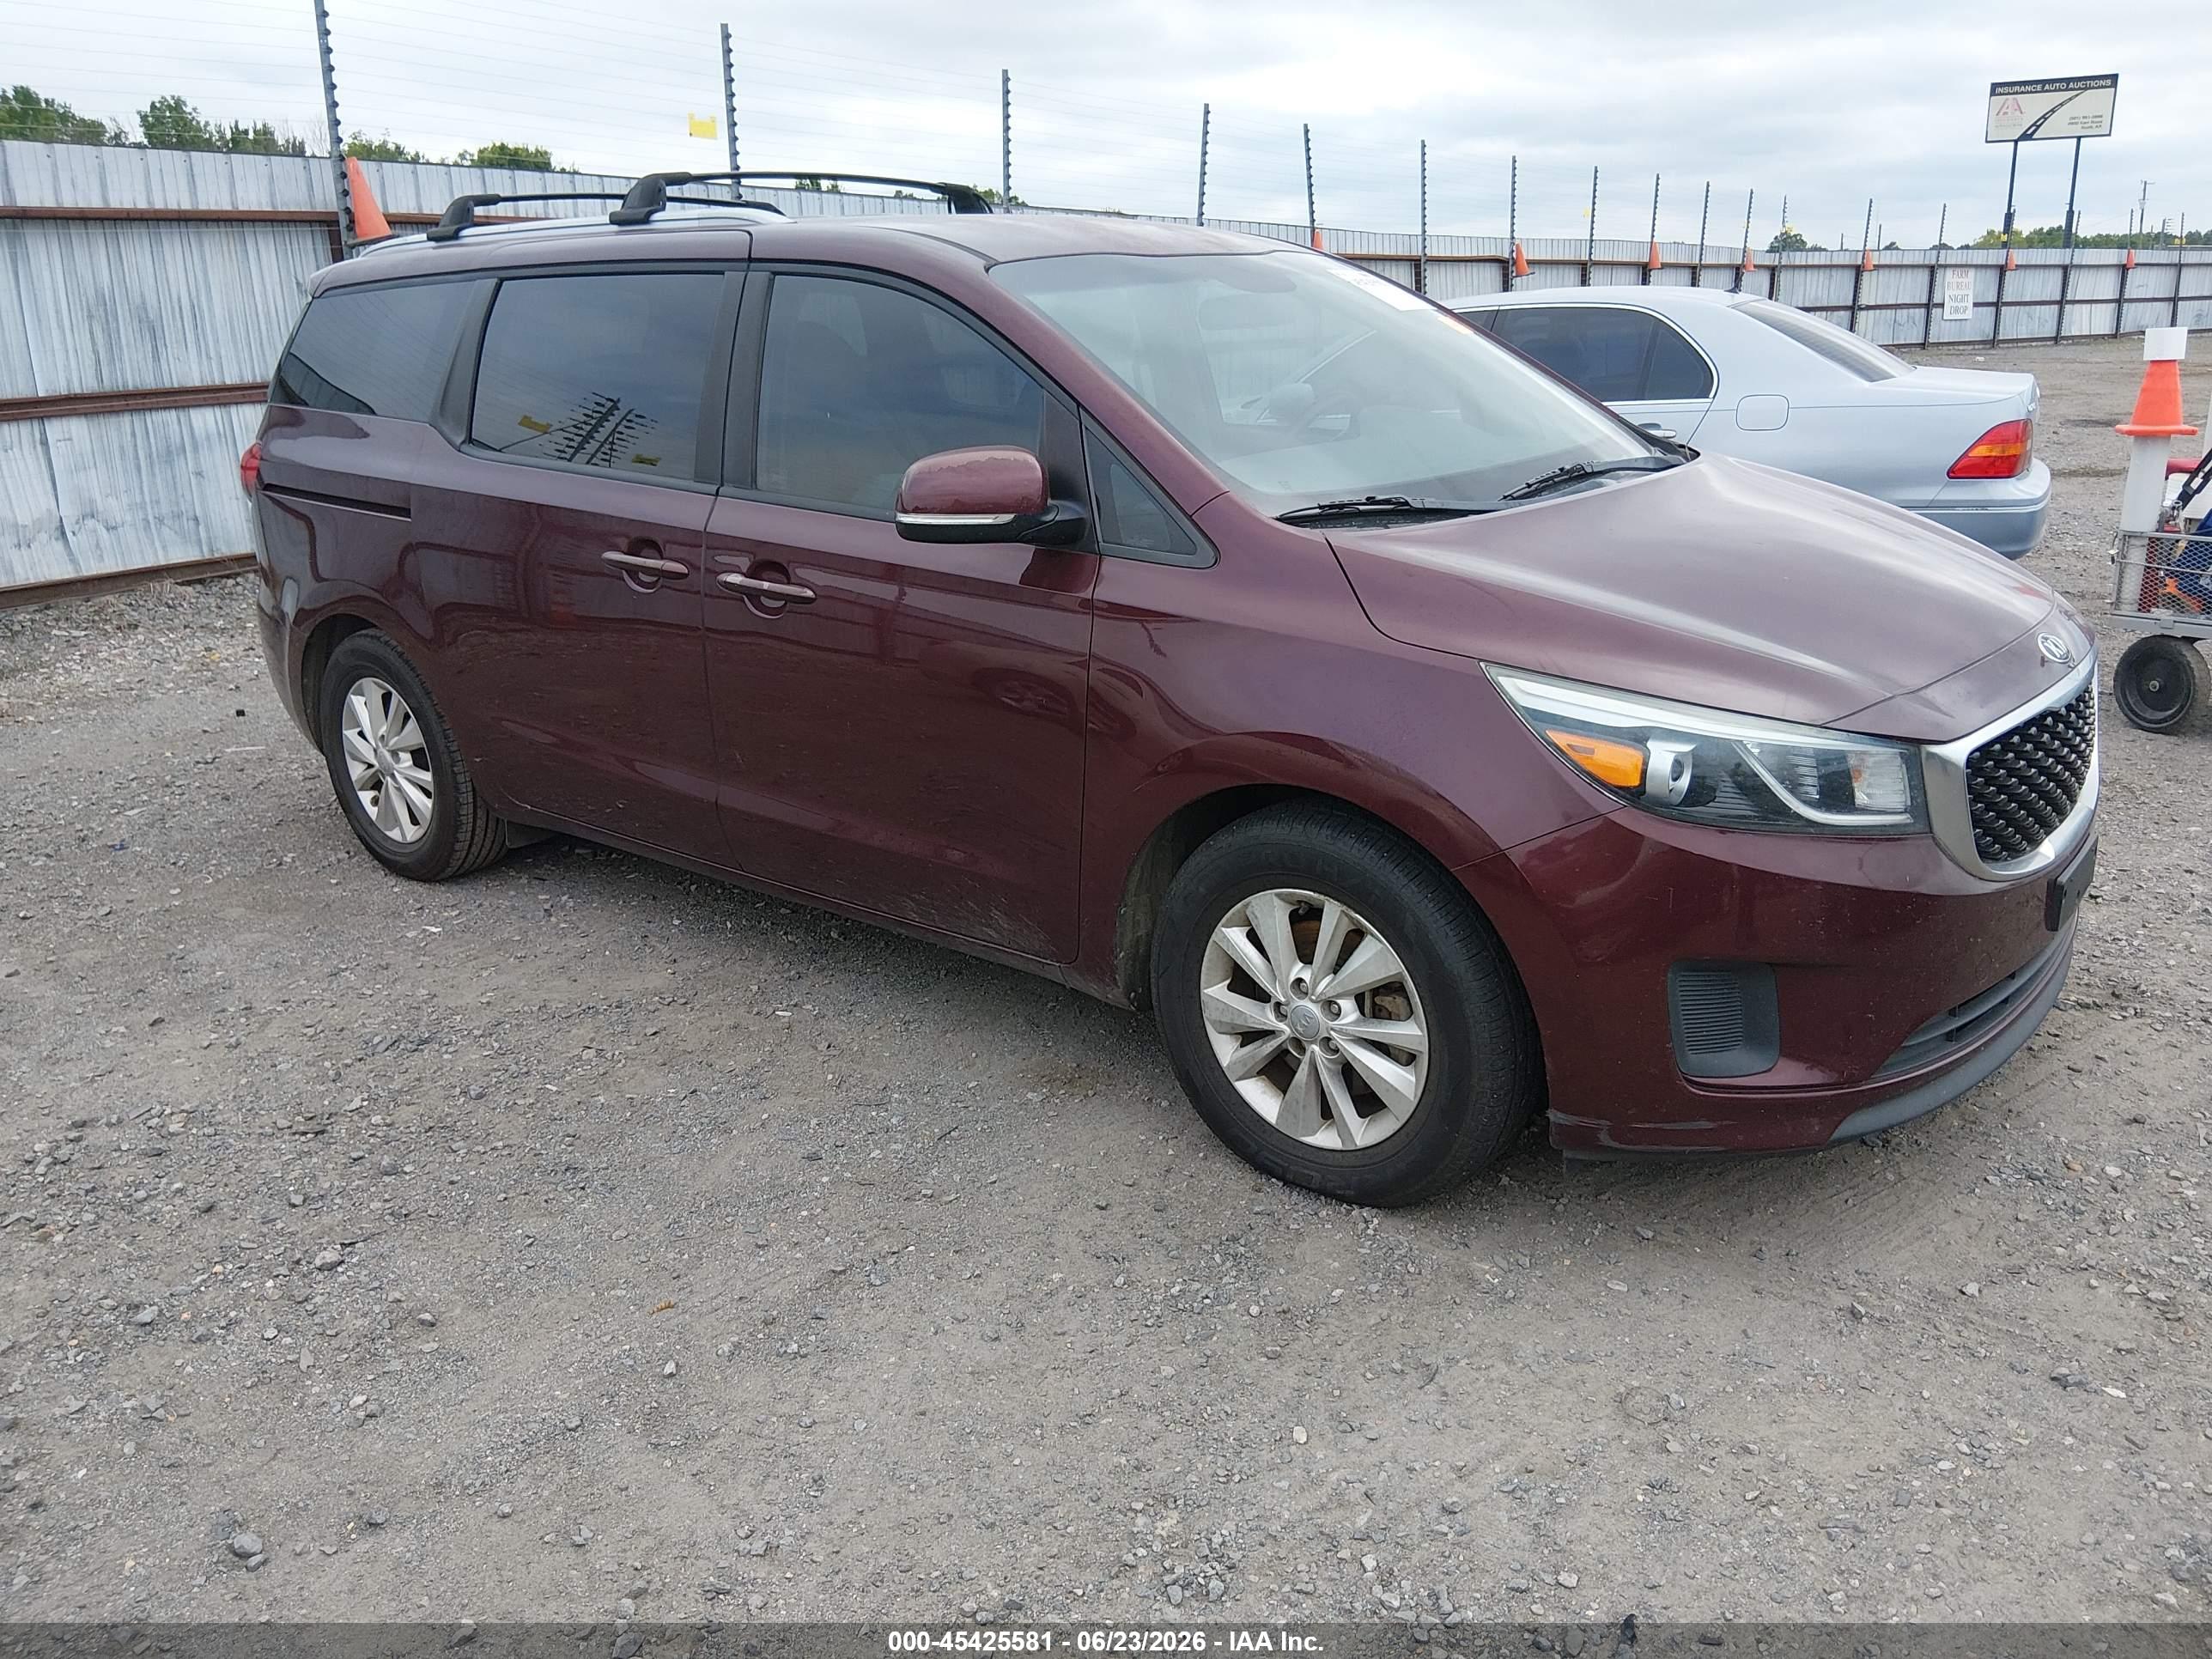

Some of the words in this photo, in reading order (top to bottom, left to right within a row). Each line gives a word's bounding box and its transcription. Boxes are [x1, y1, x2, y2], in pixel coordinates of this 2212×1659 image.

[1996, 84, 2042, 94] INSURANCE
[2044, 82, 2067, 91] AUTO
[2069, 79, 2112, 89] AUCTIONS
[1952, 269, 1969, 279] FARM
[1947, 281, 1972, 291] BUREAU
[1948, 294, 1970, 303] NIGHT
[1949, 305, 1968, 315] DROP
